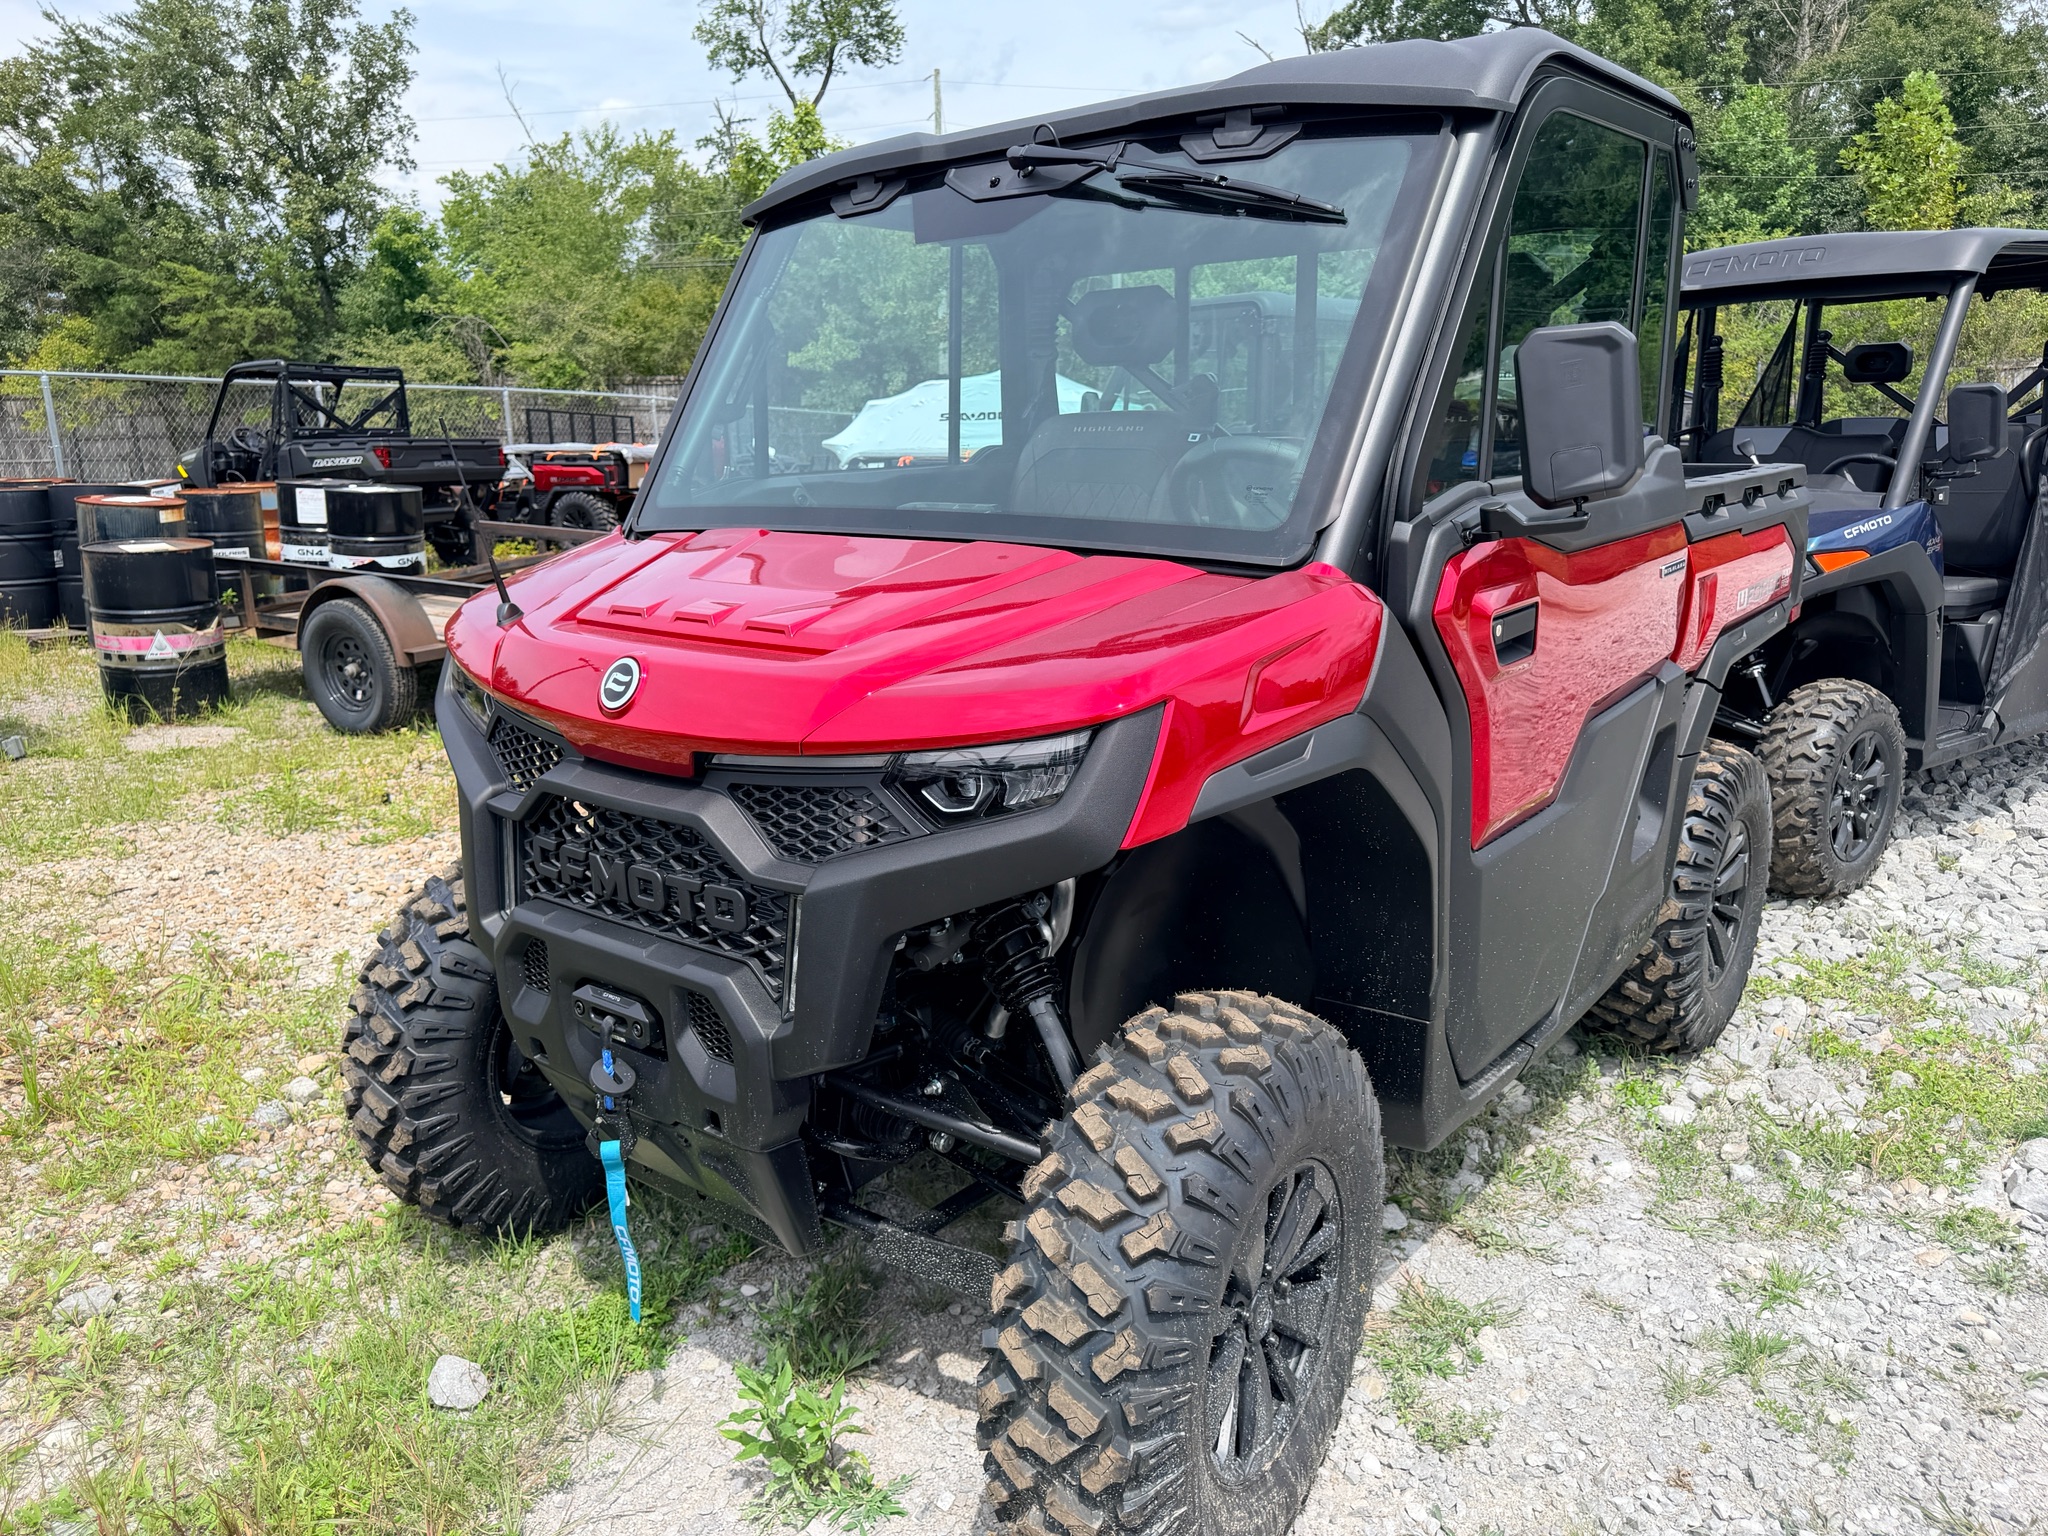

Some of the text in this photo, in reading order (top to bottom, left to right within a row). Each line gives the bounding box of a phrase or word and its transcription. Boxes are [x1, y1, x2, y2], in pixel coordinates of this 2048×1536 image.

[1685, 247, 1827, 277] CFMOTO
[1073, 425, 1144, 433] HIGHLAND
[312, 455, 364, 468] RANGER
[1843, 515, 1892, 539] CFMOTO
[297, 548, 324, 557] GN4
[531, 833, 751, 933] CFMOTO
[615, 1224, 639, 1304] CFMOTO
